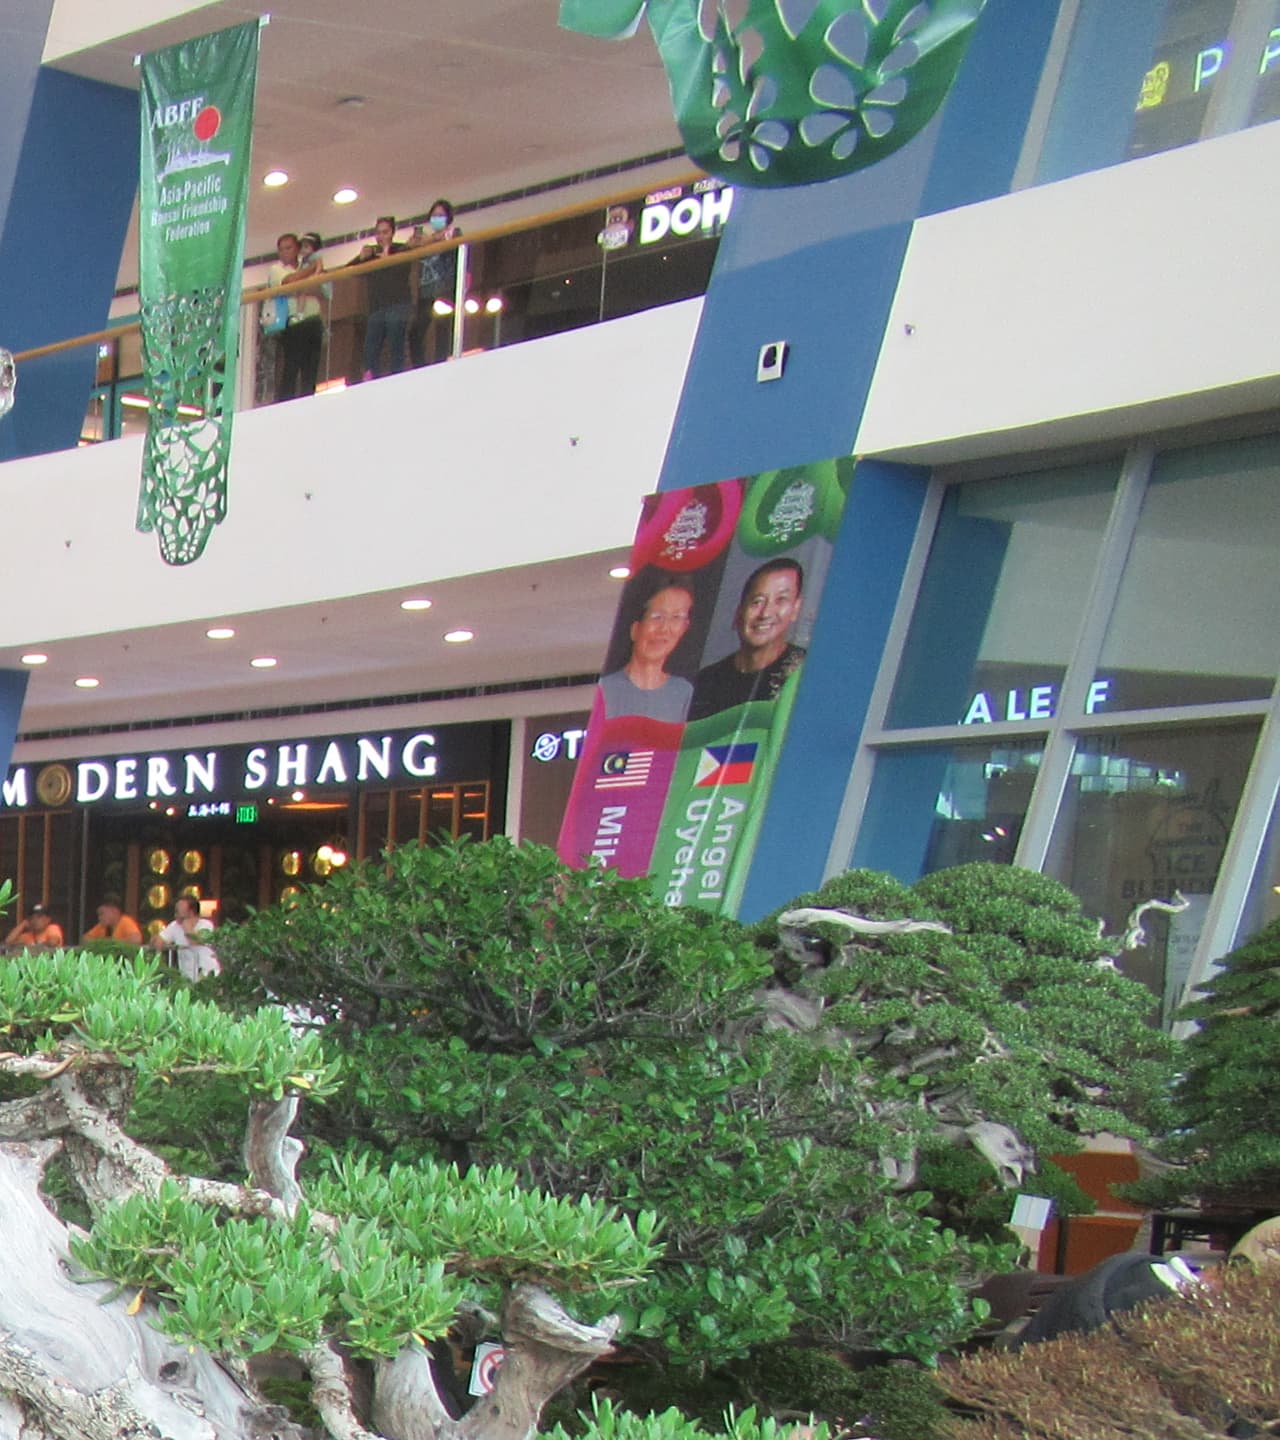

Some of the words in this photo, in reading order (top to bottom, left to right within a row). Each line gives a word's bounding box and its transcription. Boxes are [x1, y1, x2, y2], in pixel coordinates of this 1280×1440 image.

[150, 97, 204, 131] ABFF
[159, 174, 222, 207] Asia-Pacific
[182, 196, 228, 221] Friendship
[165, 219, 211, 242] Federation
[958, 691, 993, 726] A
[1007, 680, 1109, 721] LEF
[562, 729, 586, 759] T
[244, 732, 439, 790] SHANG
[698, 796, 746, 899] Angel
